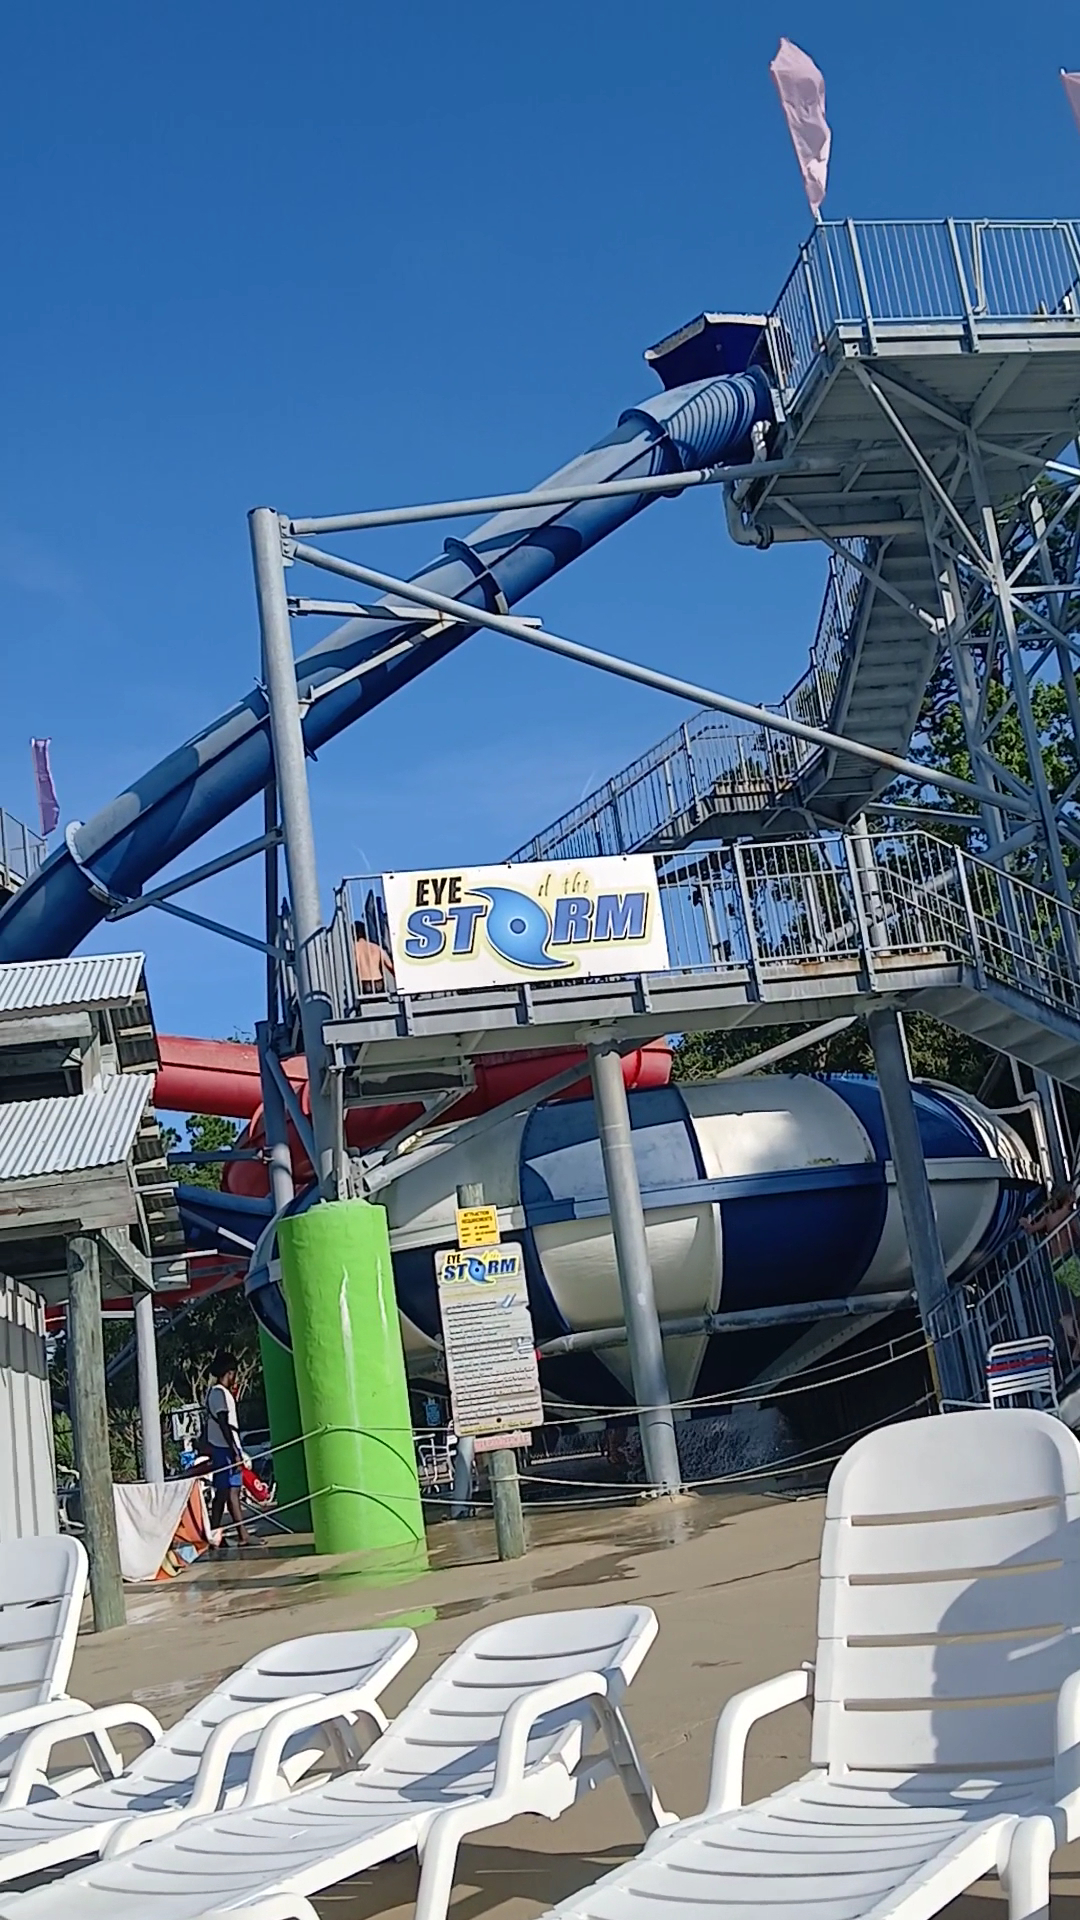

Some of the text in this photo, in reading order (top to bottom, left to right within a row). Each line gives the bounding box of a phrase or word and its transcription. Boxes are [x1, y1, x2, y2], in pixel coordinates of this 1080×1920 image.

[416, 876, 462, 907] EYE
[404, 889, 648, 967] STORM
[443, 1258, 517, 1283] STORM
[446, 1254, 461, 1264] EYE
